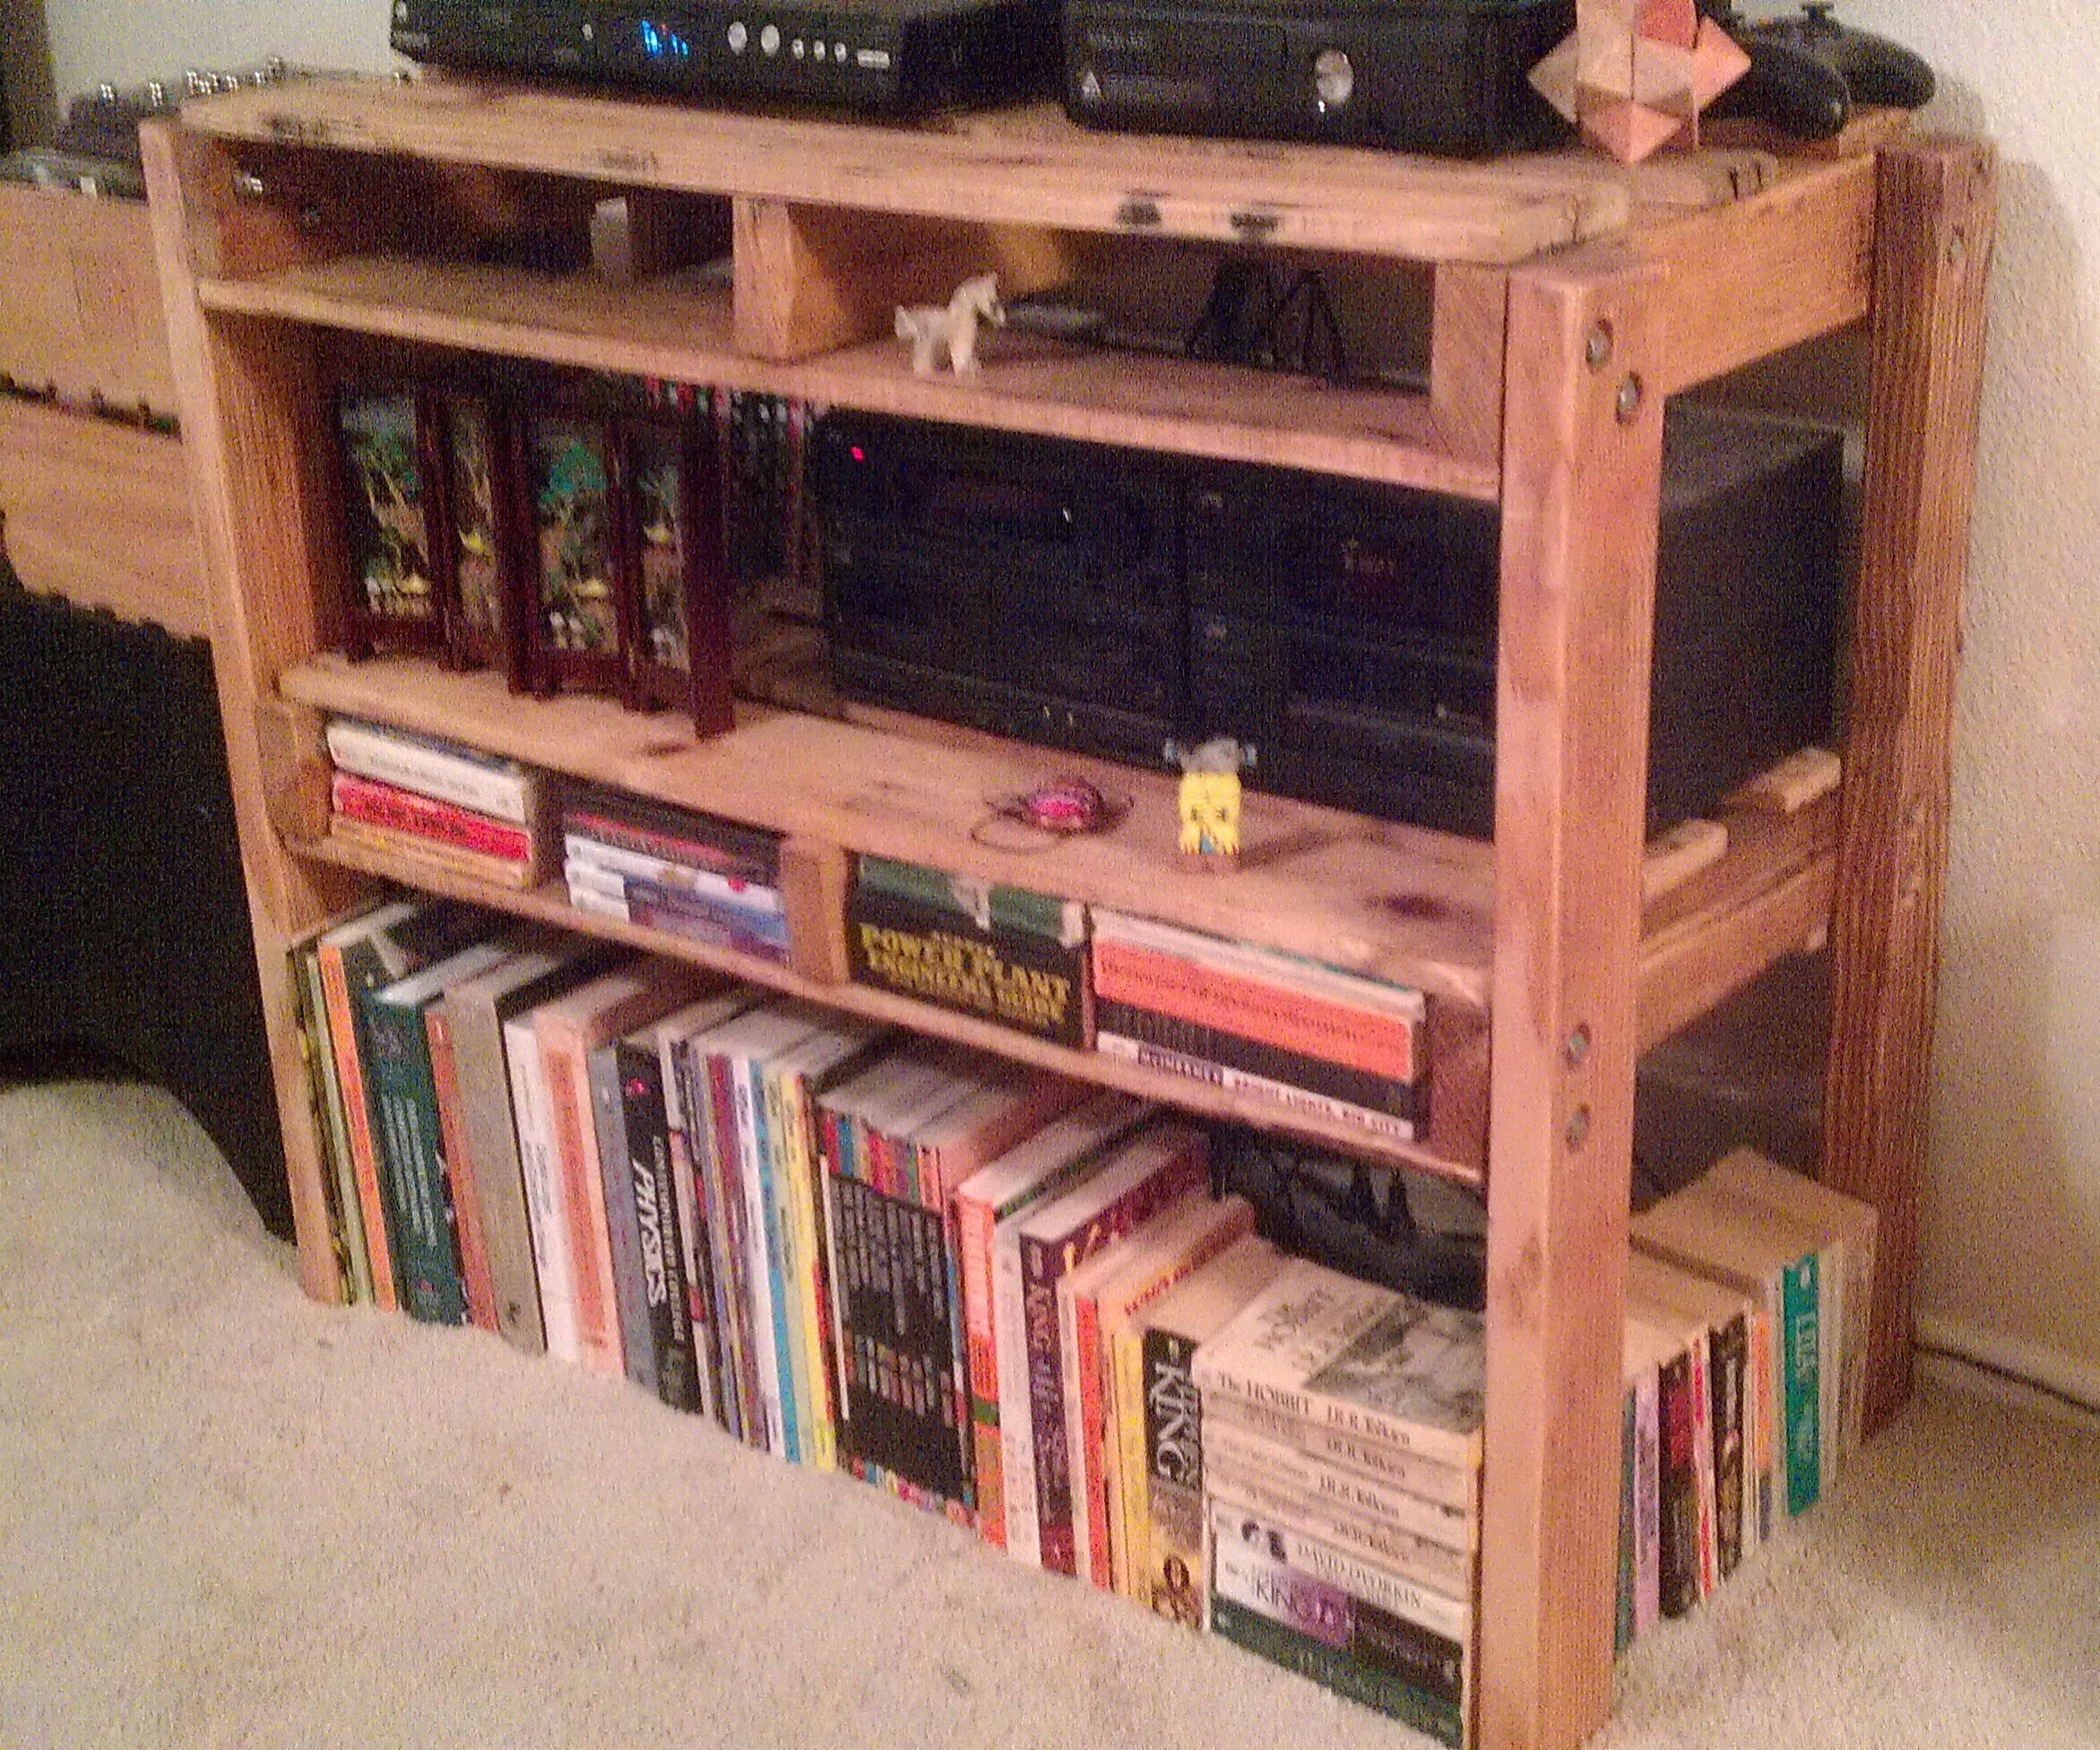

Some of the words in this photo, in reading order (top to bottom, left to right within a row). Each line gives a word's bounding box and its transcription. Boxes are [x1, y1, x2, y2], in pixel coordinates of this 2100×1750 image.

[973, 955, 1068, 1002] PLANT
[632, 1159, 670, 1306] PHYSICS
[1150, 1362, 1188, 1481] KING
[1248, 1379, 1309, 1415] HOBBIT
